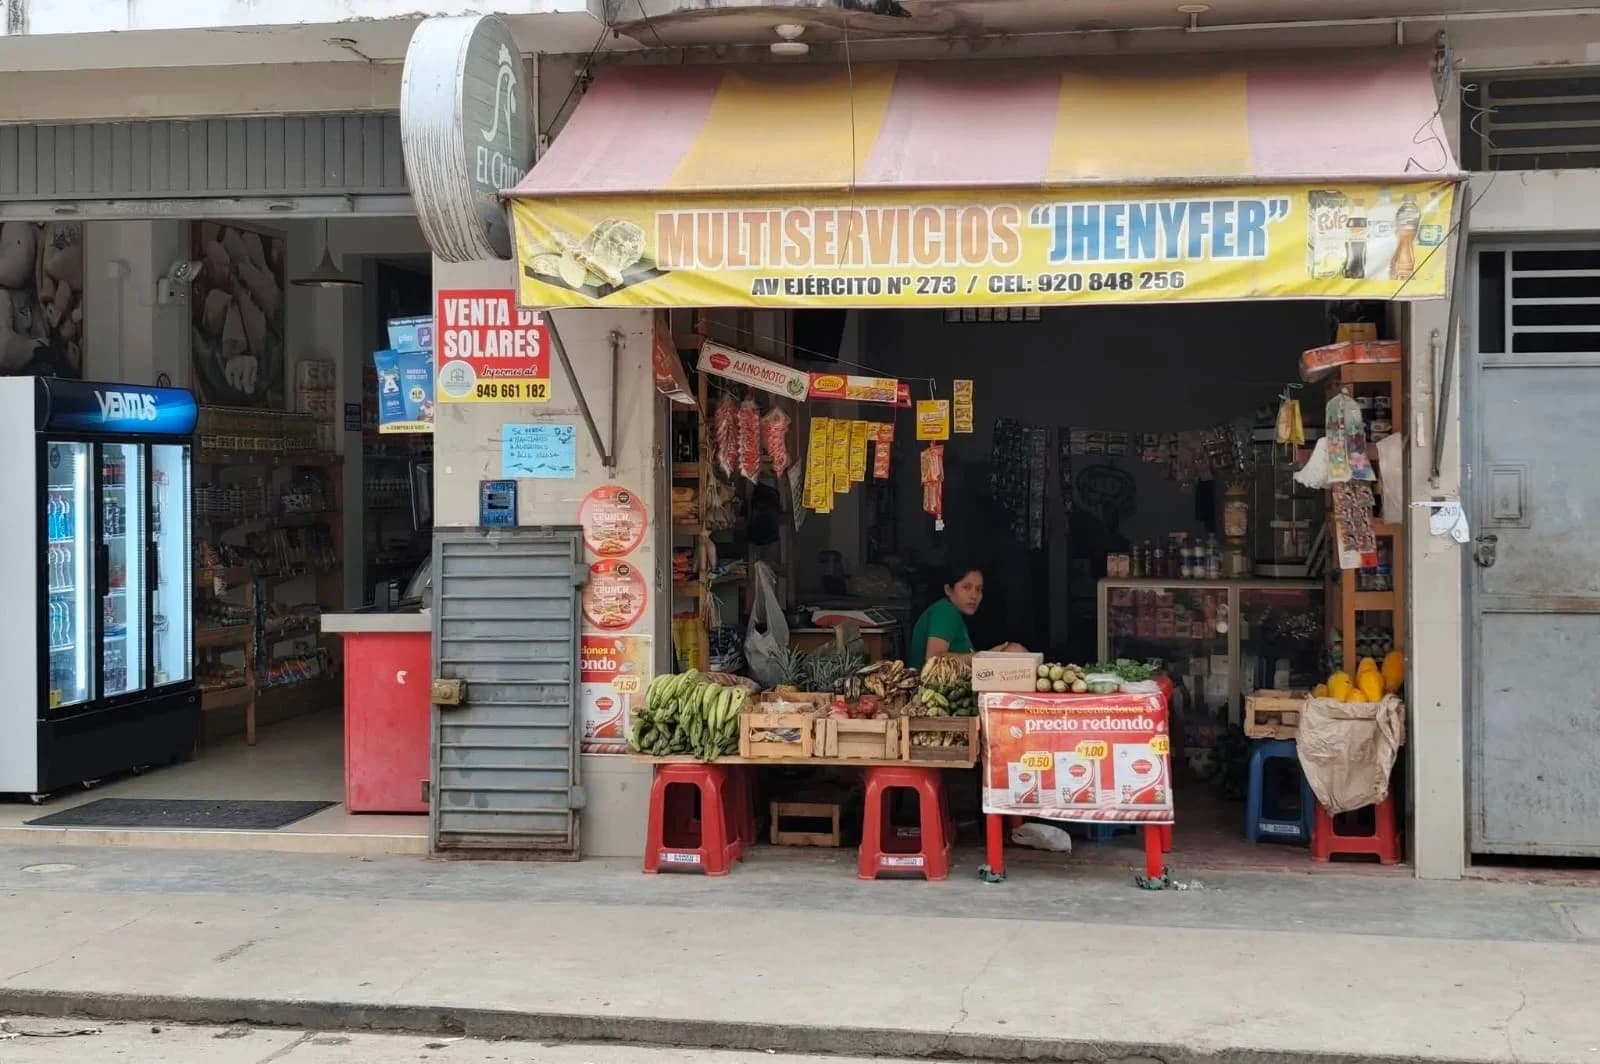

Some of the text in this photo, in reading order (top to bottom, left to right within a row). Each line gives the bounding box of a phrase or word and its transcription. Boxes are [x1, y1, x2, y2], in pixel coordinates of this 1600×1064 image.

[476, 145, 489, 184] El
[656, 205, 1021, 270] MULTISERVICIOS
[751, 277, 780, 296] AV
[784, 272, 881, 296] EJÉRCITO
[915, 275, 957, 294] 273
[966, 276, 978, 294] /
[988, 273, 1033, 294] CEL:
[1037, 272, 1082, 293] 920
[1087, 272, 1134, 292] 848
[1138, 271, 1186, 290] 256
[444, 298, 511, 327] VENTA
[444, 329, 540, 358] SOLARES
[482, 364, 522, 378] Informes
[476, 383, 498, 398] 949
[501, 383, 521, 398] 661
[525, 383, 546, 398] 182
[93, 390, 157, 424] VENTUS
[1025, 715, 1154, 733] precio redondo
